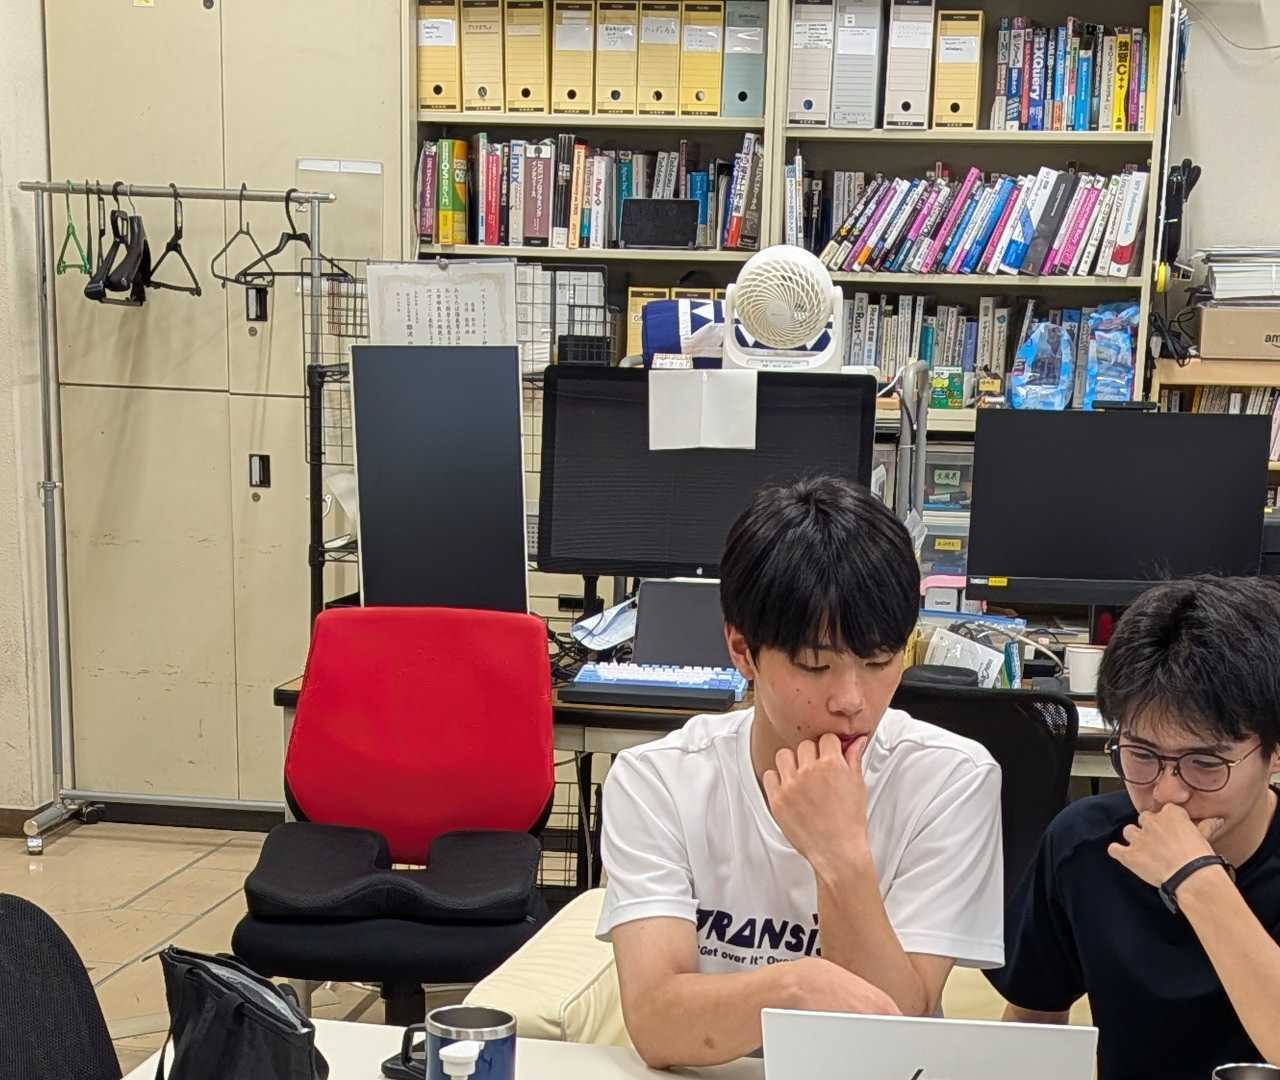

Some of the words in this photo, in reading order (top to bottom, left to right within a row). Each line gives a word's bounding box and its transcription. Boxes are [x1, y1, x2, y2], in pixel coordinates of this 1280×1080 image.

[510, 143, 524, 184] Linux
[696, 908, 822, 957] TRANSi
[721, 949, 747, 964] over
